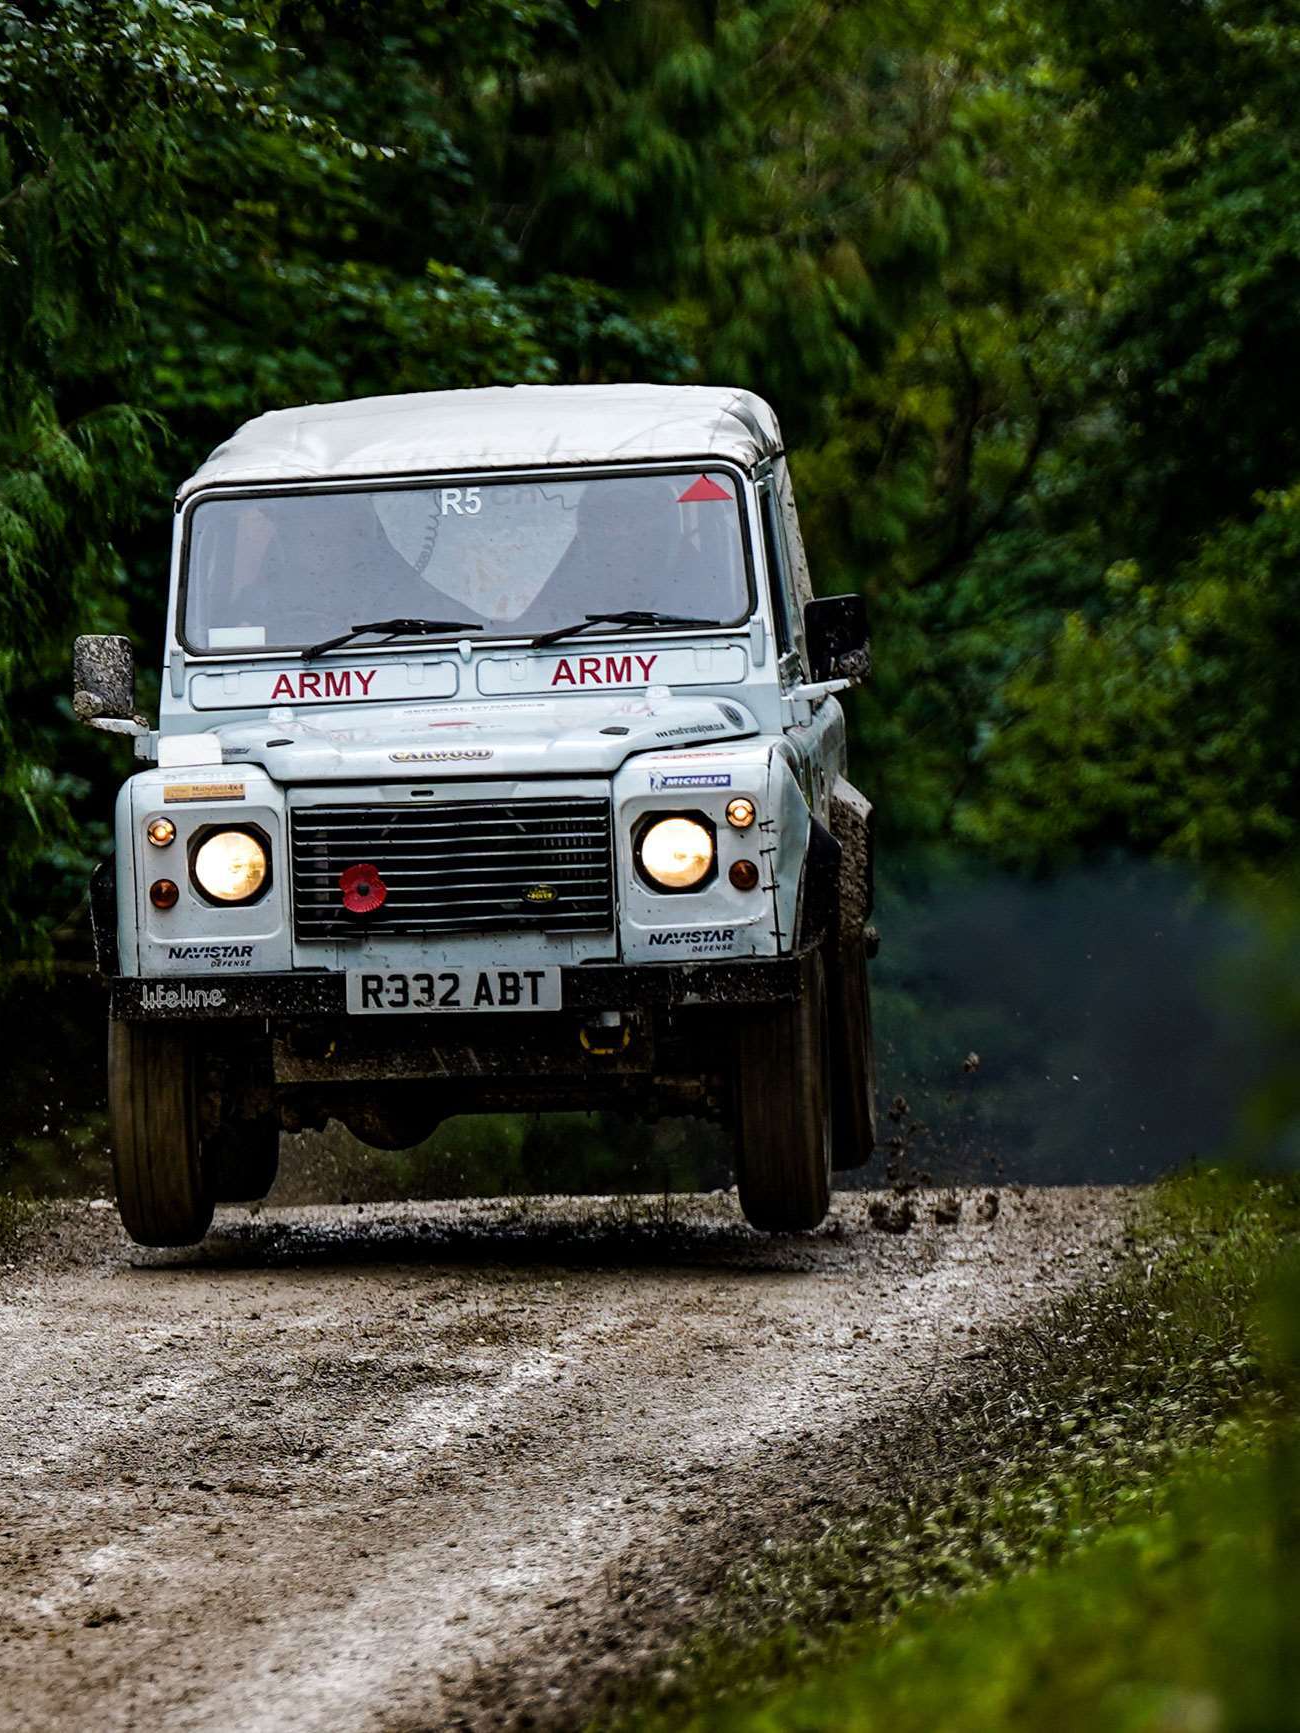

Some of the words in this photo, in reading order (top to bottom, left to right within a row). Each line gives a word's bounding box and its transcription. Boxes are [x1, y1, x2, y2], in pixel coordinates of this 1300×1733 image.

[441, 487, 482, 515] R5
[551, 654, 658, 686] ARMY
[270, 669, 377, 700] ARMY
[665, 775, 729, 786] MICHELIN
[649, 930, 735, 945] NAVISTAR
[168, 945, 254, 959] NAVISTAR
[692, 944, 732, 952] DEFENSE
[211, 959, 251, 968] DEFENSE
[361, 973, 460, 1009] R332
[473, 971, 545, 1006] ABT
